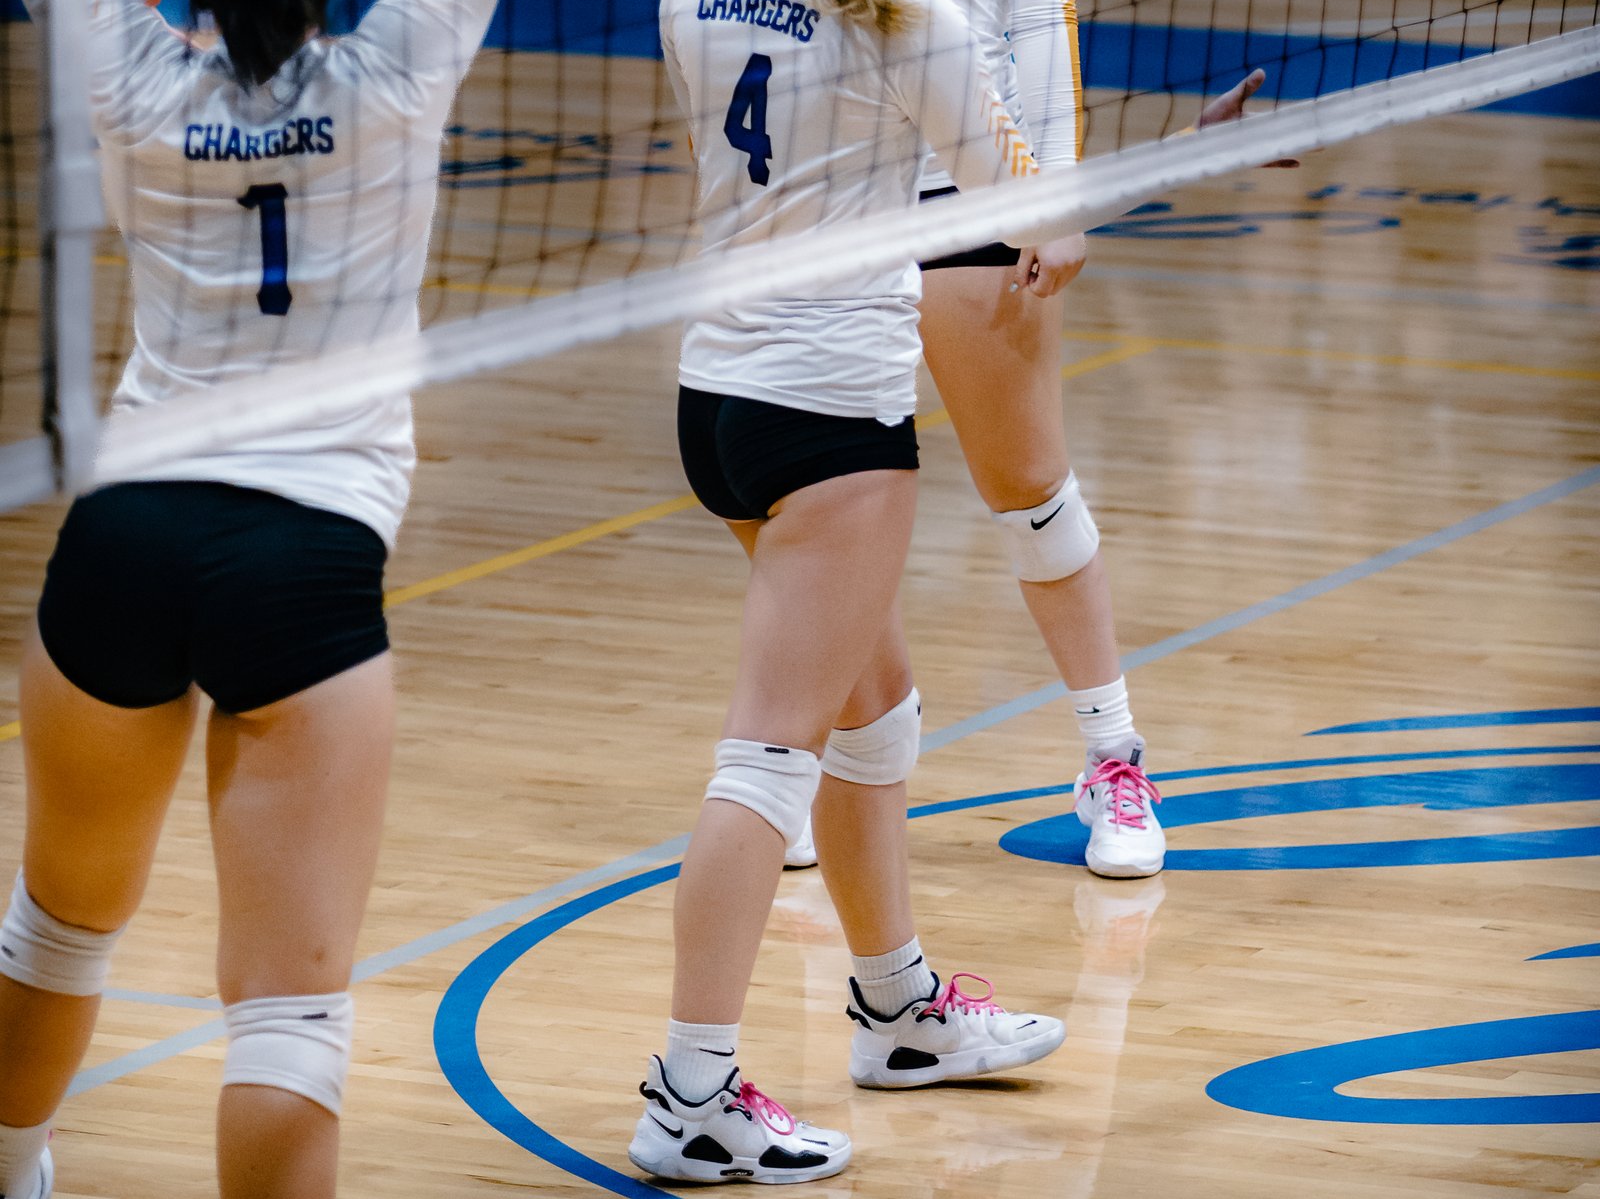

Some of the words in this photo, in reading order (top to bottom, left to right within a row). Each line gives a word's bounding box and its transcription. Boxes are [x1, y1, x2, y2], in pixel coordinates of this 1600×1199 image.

[184, 116, 334, 161] CHARGERS
[724, 53, 772, 186] 4
[237, 183, 292, 315] 1
